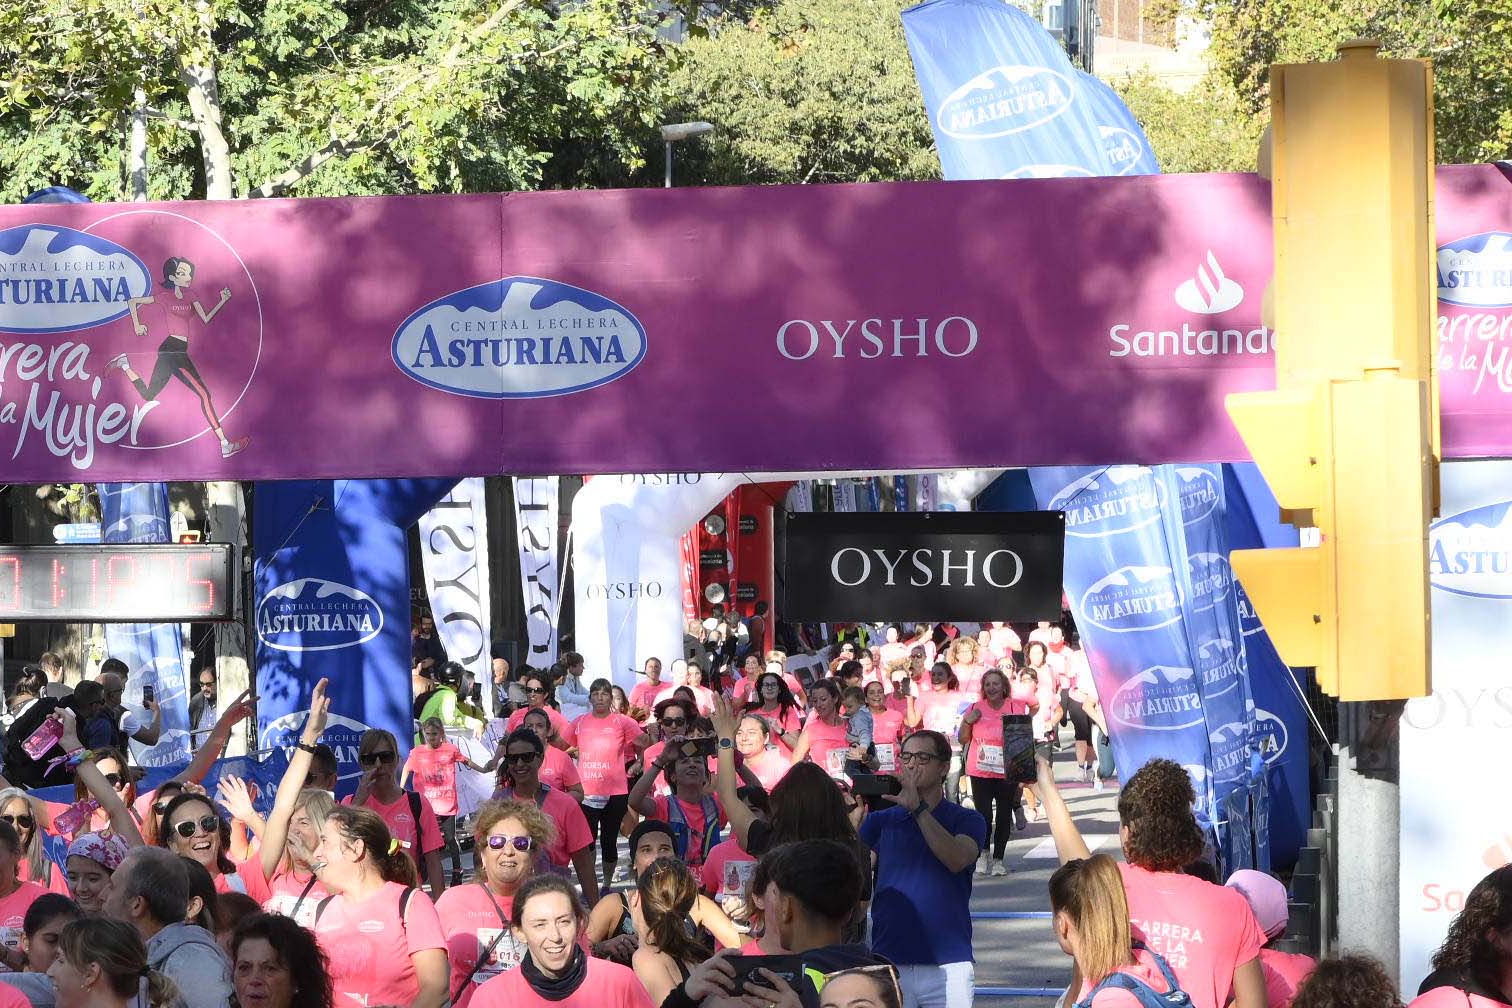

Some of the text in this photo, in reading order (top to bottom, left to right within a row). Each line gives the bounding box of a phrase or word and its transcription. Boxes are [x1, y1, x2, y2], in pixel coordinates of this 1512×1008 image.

[54, 260, 126, 272] LECHERA
[451, 317, 619, 333] CENTRAL LECHERA
[776, 316, 979, 361] OYSHO
[411, 324, 627, 370] ASTURIANA
[11, 375, 160, 470] Mujer
[830, 547, 1024, 588] OYSHO
[586, 582, 663, 601] OYSHO
[321, 602, 370, 611] LECHERA
[261, 607, 375, 635] ASTURIANA
